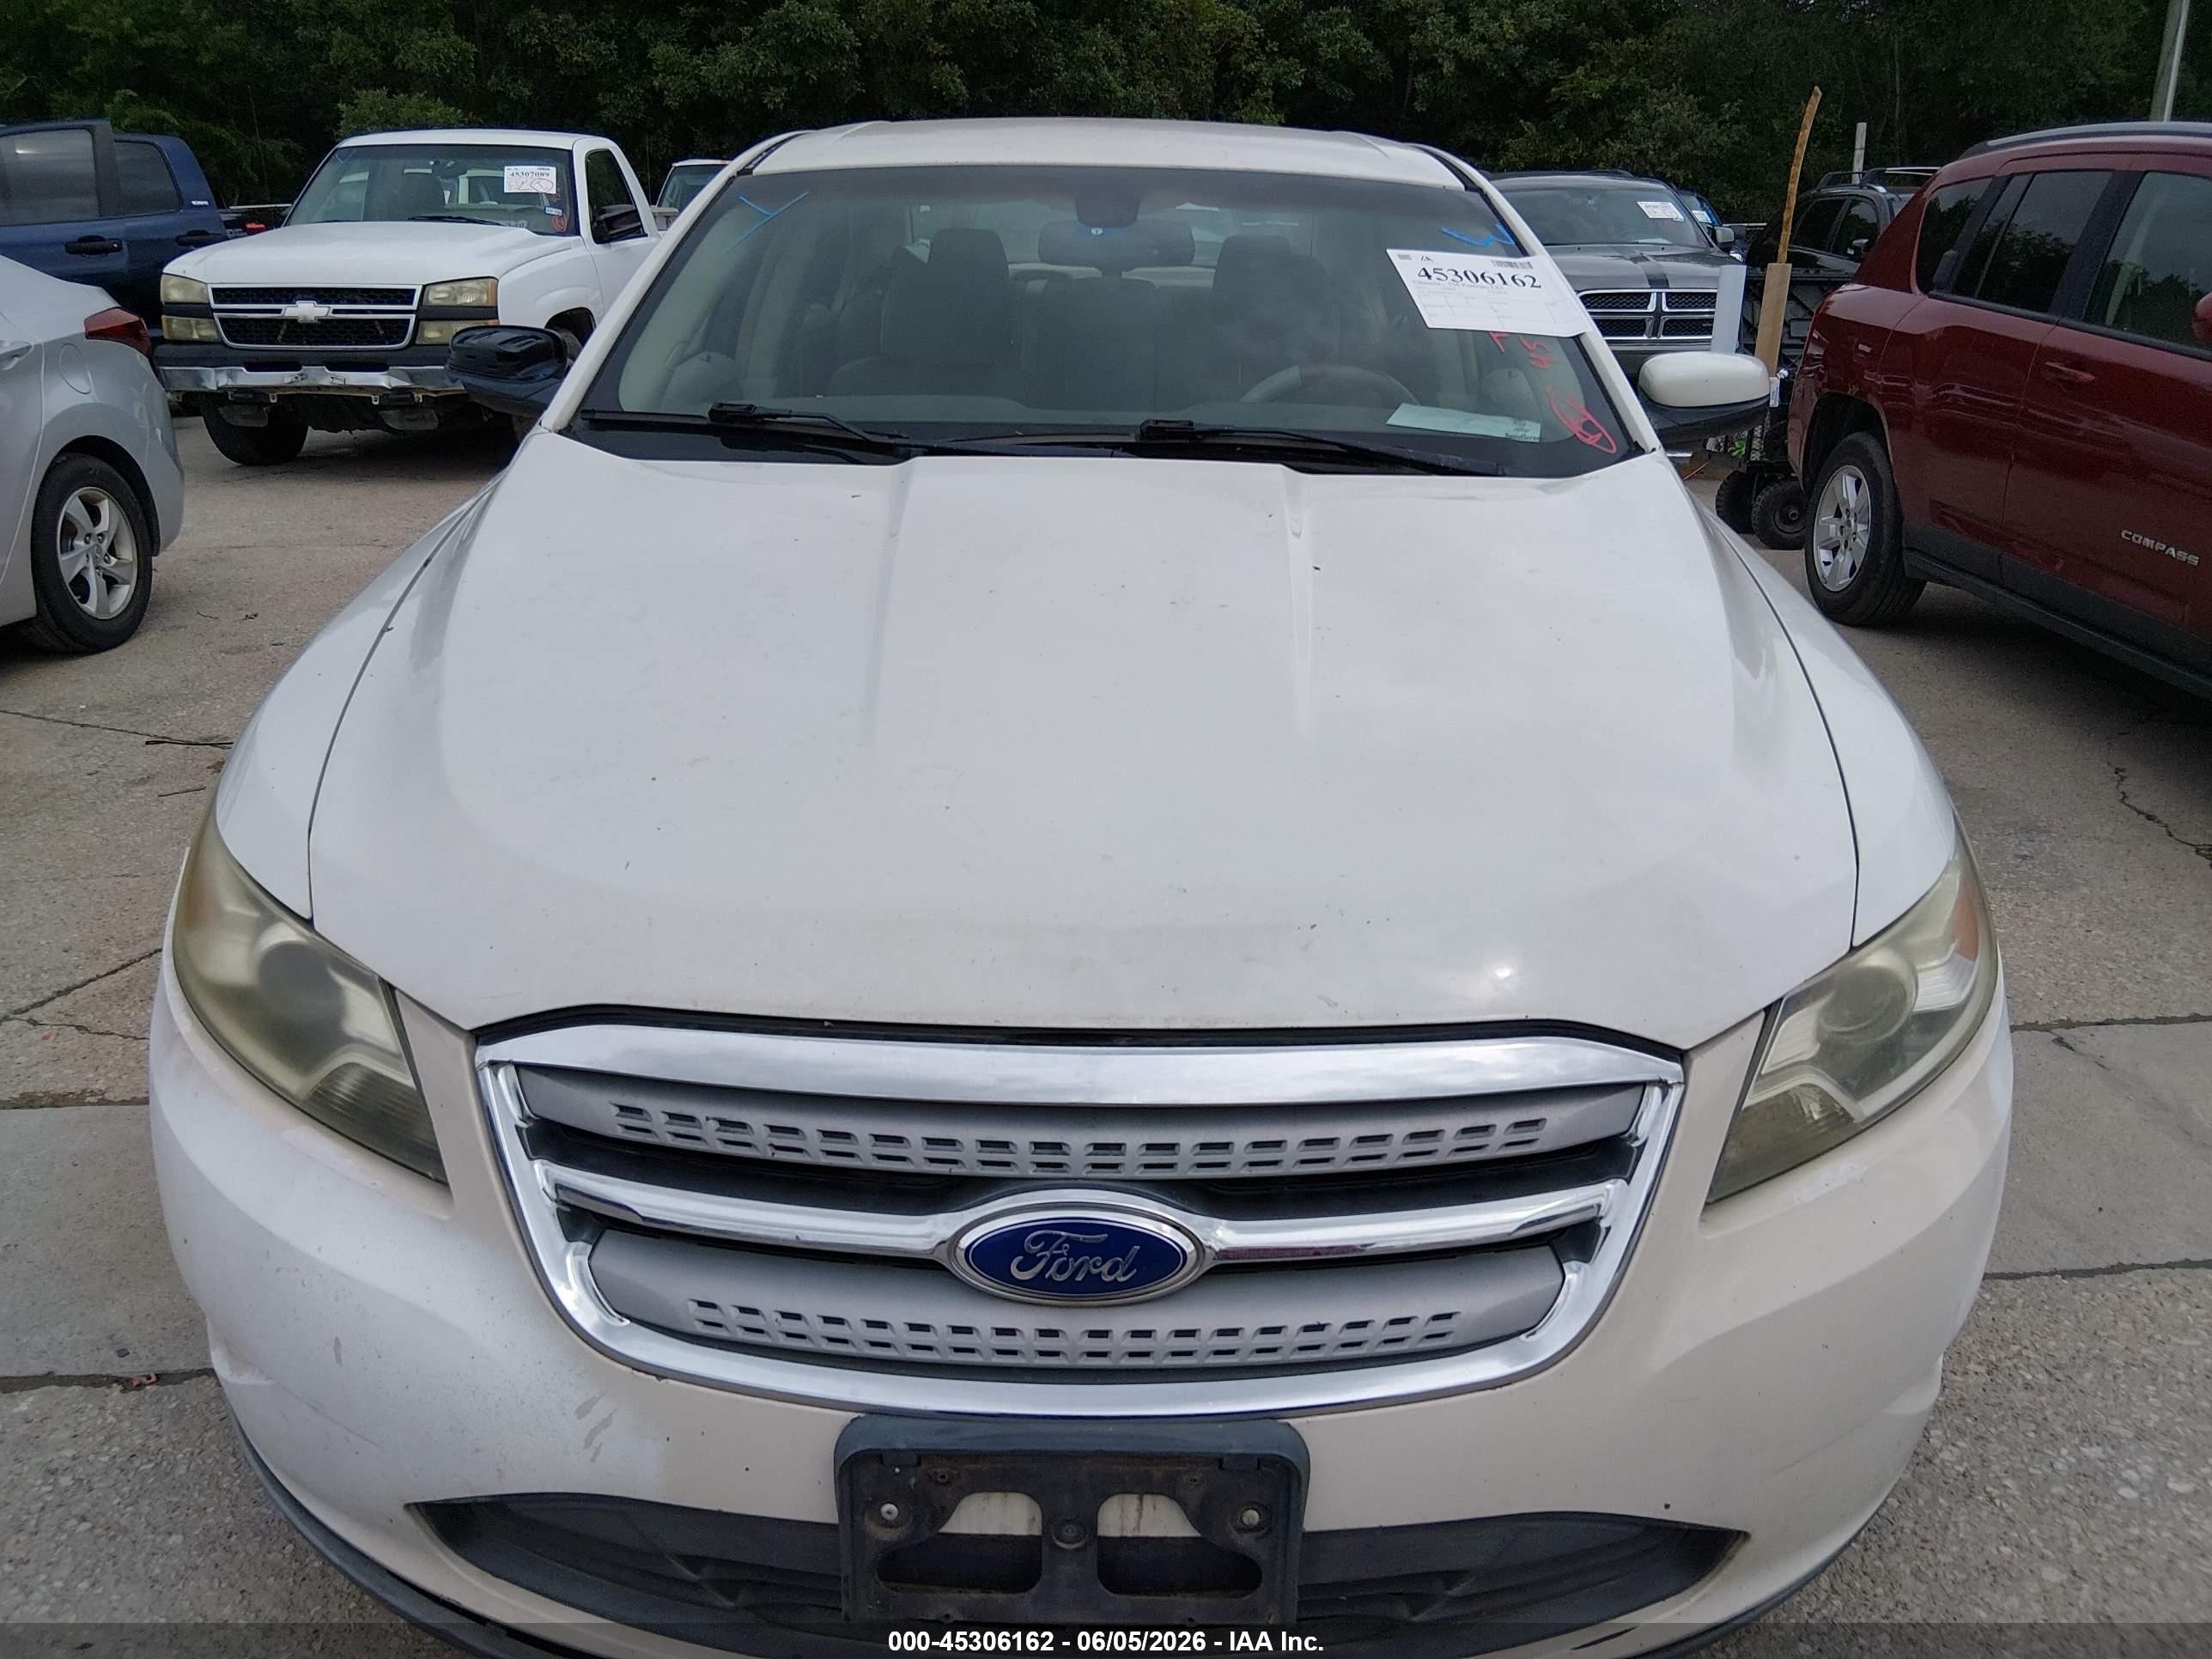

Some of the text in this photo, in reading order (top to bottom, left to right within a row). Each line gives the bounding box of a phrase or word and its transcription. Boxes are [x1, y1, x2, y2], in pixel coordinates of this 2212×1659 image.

[1417, 267, 1542, 289] 45306162
[2121, 529, 2199, 567] COMPASS
[1010, 1230, 1140, 1282] Ford
